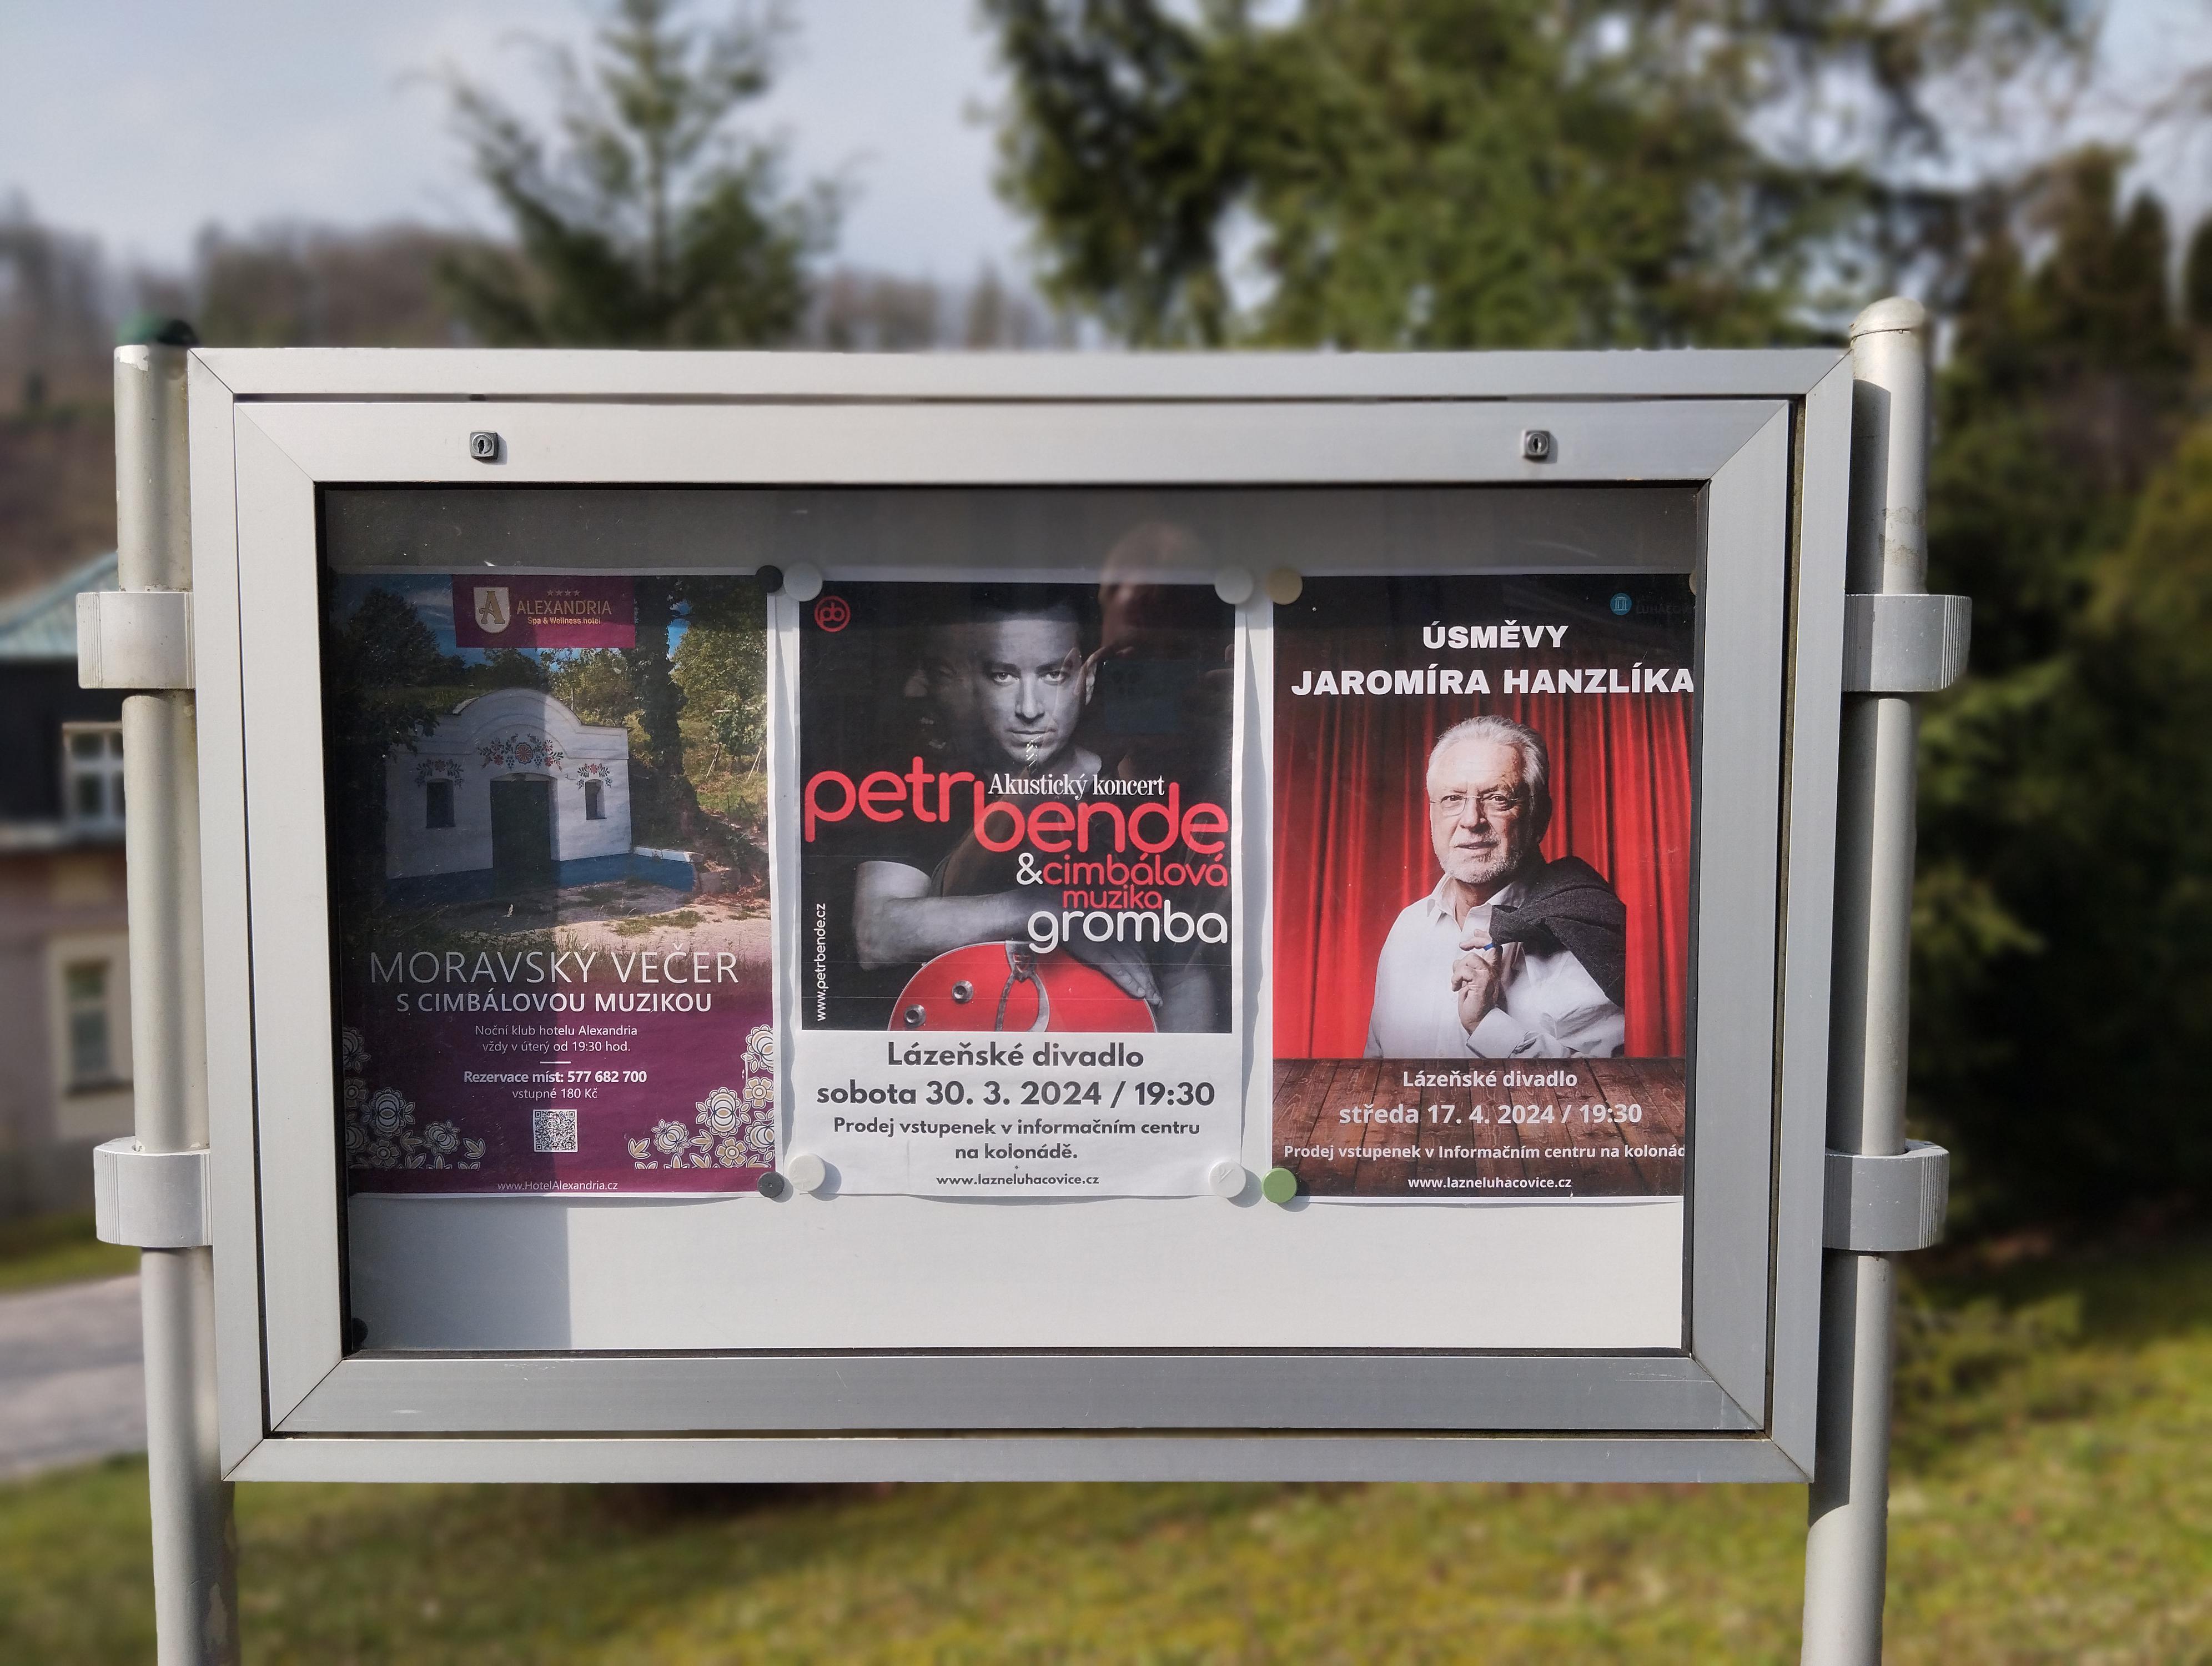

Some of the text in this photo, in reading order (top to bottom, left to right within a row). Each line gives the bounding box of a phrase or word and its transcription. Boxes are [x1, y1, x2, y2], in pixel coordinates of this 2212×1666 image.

[517, 600, 612, 615] ALEXANDRIA
[528, 617, 541, 625] Spa
[1423, 620, 1568, 649] ÚSMĚVY
[1291, 663, 1694, 695] JAROMÍRA HANZLÍKA
[988, 774, 1165, 801] Akustický koncert
[805, 756, 974, 842] petr
[973, 781, 1229, 854] bende
[1063, 887, 1163, 909] muzika
[1027, 901, 1228, 954] gromba
[370, 943, 740, 983] MORAVSKÝ VEČER
[816, 903, 830, 1021] www.petrbende.cz
[397, 988, 712, 1012] S CIMBÁLOVOU MUZIKOU
[475, 1025, 637, 1036] Noční klub hotelu Alexandria
[482, 1041, 631, 1054] vždy v úterý od 19:30 hod.
[888, 1042, 1144, 1067] Lázeňské divadlo
[464, 1071, 647, 1083] Rezervace míst: 577 682 700
[1404, 1071, 1577, 1087] Lázeňské divadlo
[512, 1088, 597, 1102] vstupné 180 Kč
[817, 1080, 1215, 1108] sobota 30. 3. 2024 / 19:30
[1339, 1104, 1641, 1124] středa 17. 4. 2024 / 19:30
[834, 1118, 1200, 1138] Prodej vstupenek v informačním centru
[956, 1143, 1078, 1160] na kolonádě.
[1284, 1145, 1334, 1161] Prodej
[1339, 1145, 1421, 1161] vstupenek
[1426, 1148, 1434, 1158] v
[1439, 1145, 1540, 1158] Informačním
[1545, 1147, 1596, 1158] centru
[1601, 1147, 1619, 1157] na
[497, 1180, 618, 1191] www.HotelAlexandria.cz
[936, 1174, 1099, 1185] www.lazneluhacovice.cz
[1408, 1177, 1571, 1188] www.lazneluhacovice.cz
